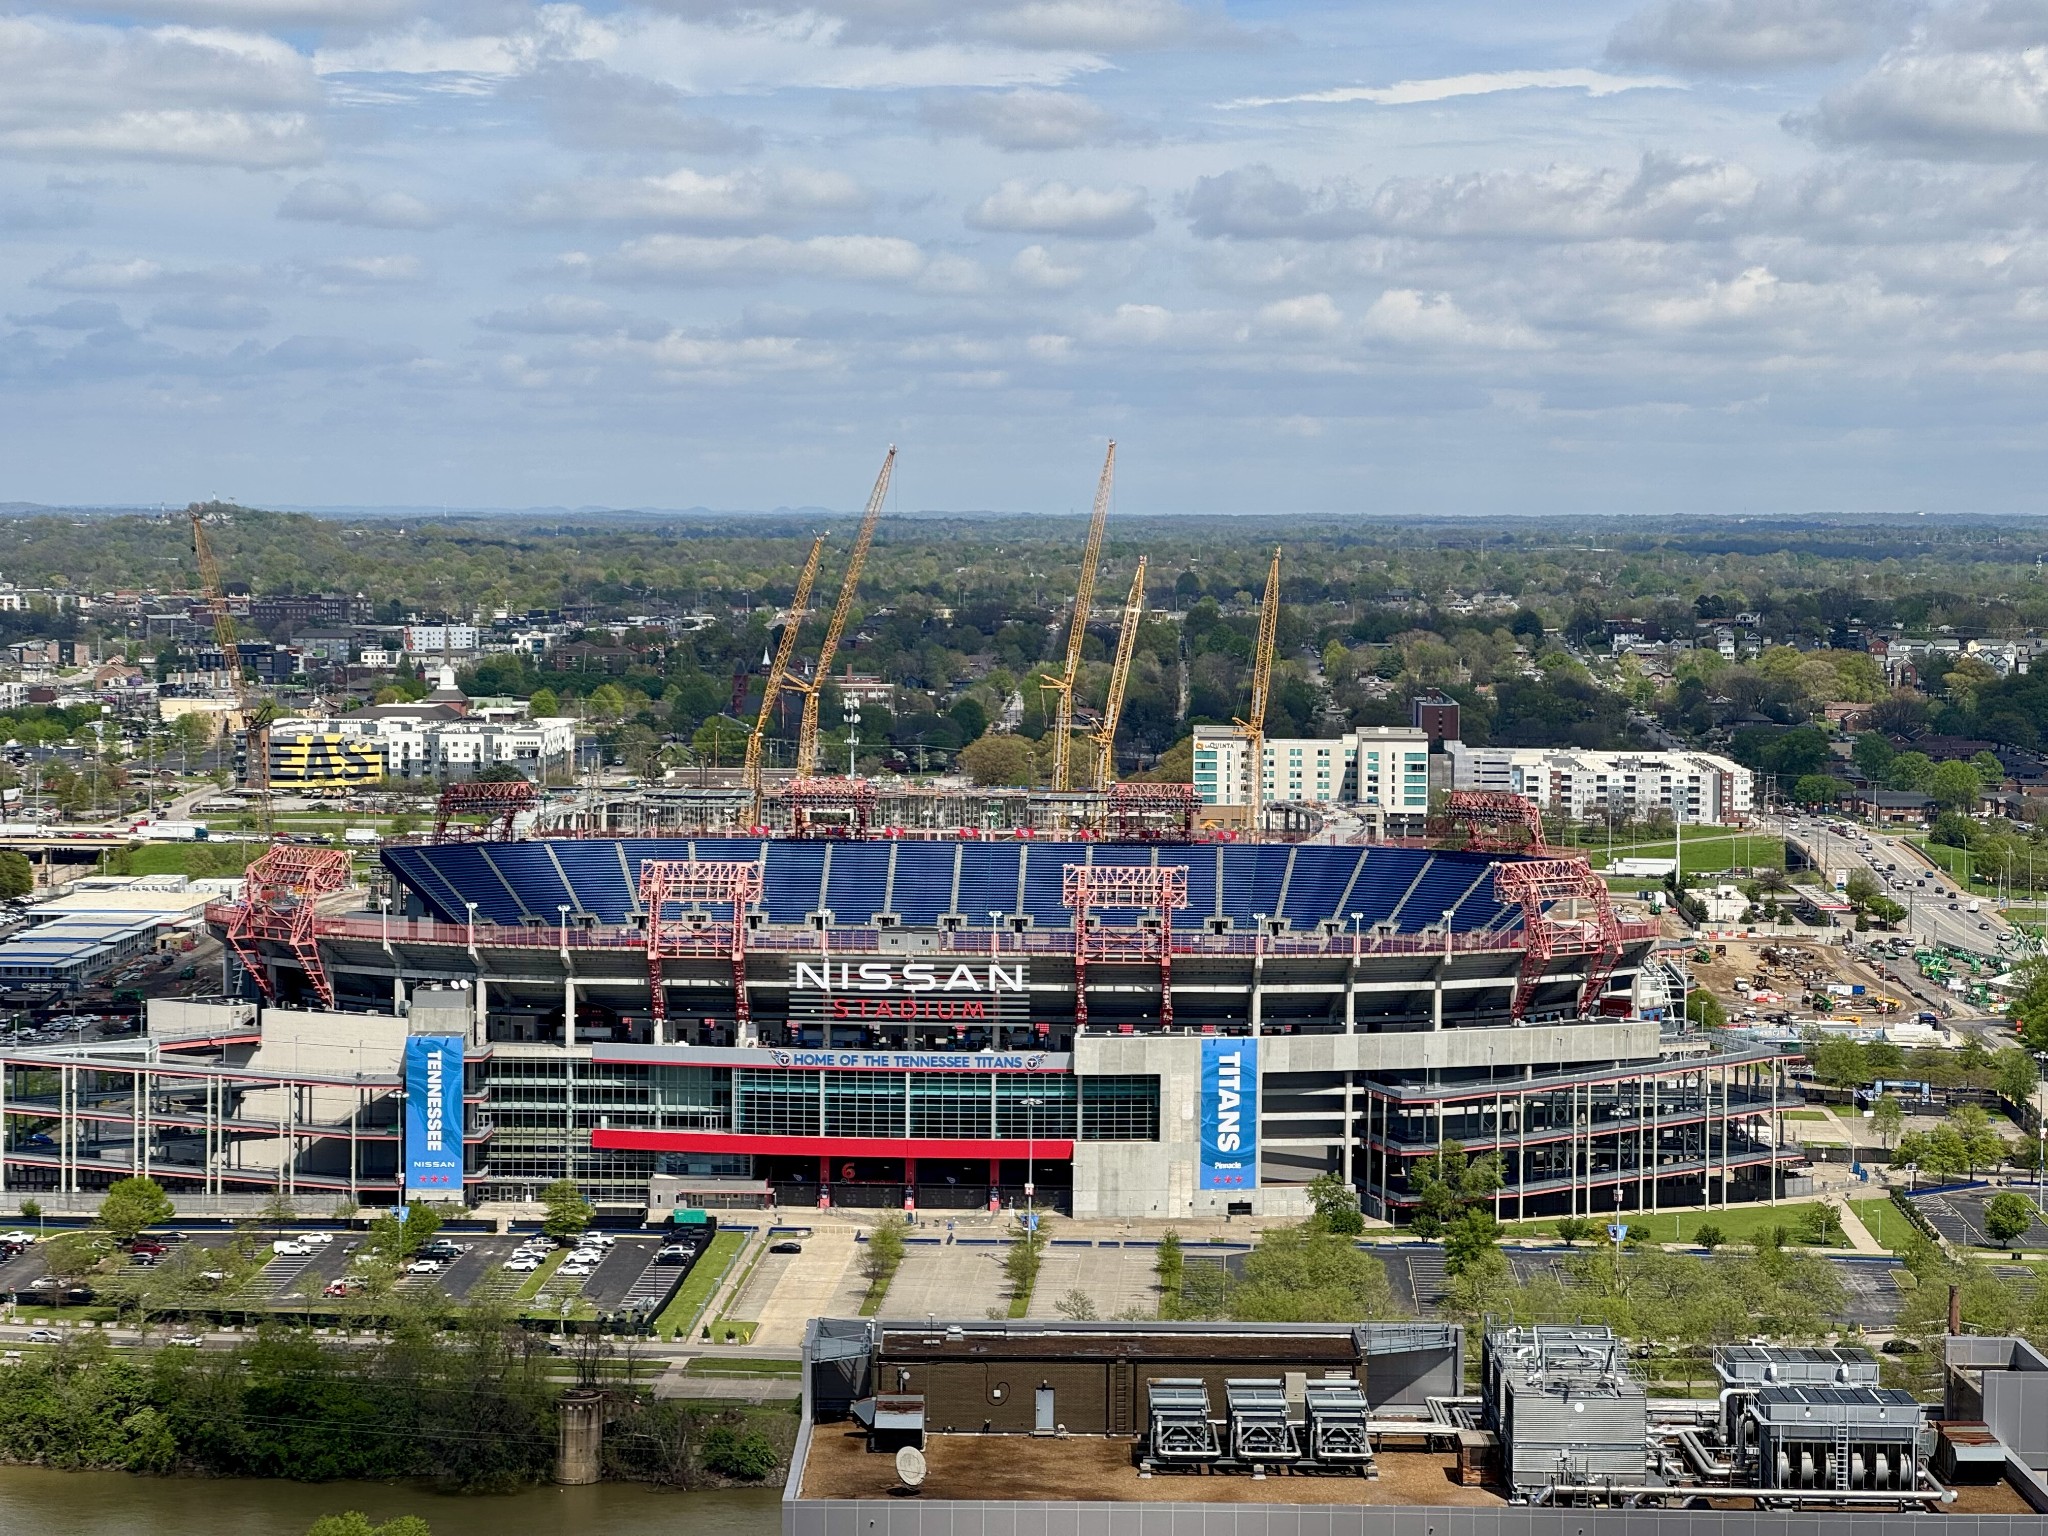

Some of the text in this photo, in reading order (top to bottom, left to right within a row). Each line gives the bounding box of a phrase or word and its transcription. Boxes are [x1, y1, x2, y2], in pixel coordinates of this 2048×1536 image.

[796, 962, 1023, 992] NISSAN
[833, 998, 985, 1020] STADIUM
[794, 1053, 1022, 1068] HOME OF THE TENNESSEE TITANS
[427, 1050, 442, 1151] TENNESSEE
[1217, 1051, 1241, 1152] TITANS
[841, 1162, 856, 1179] 6
